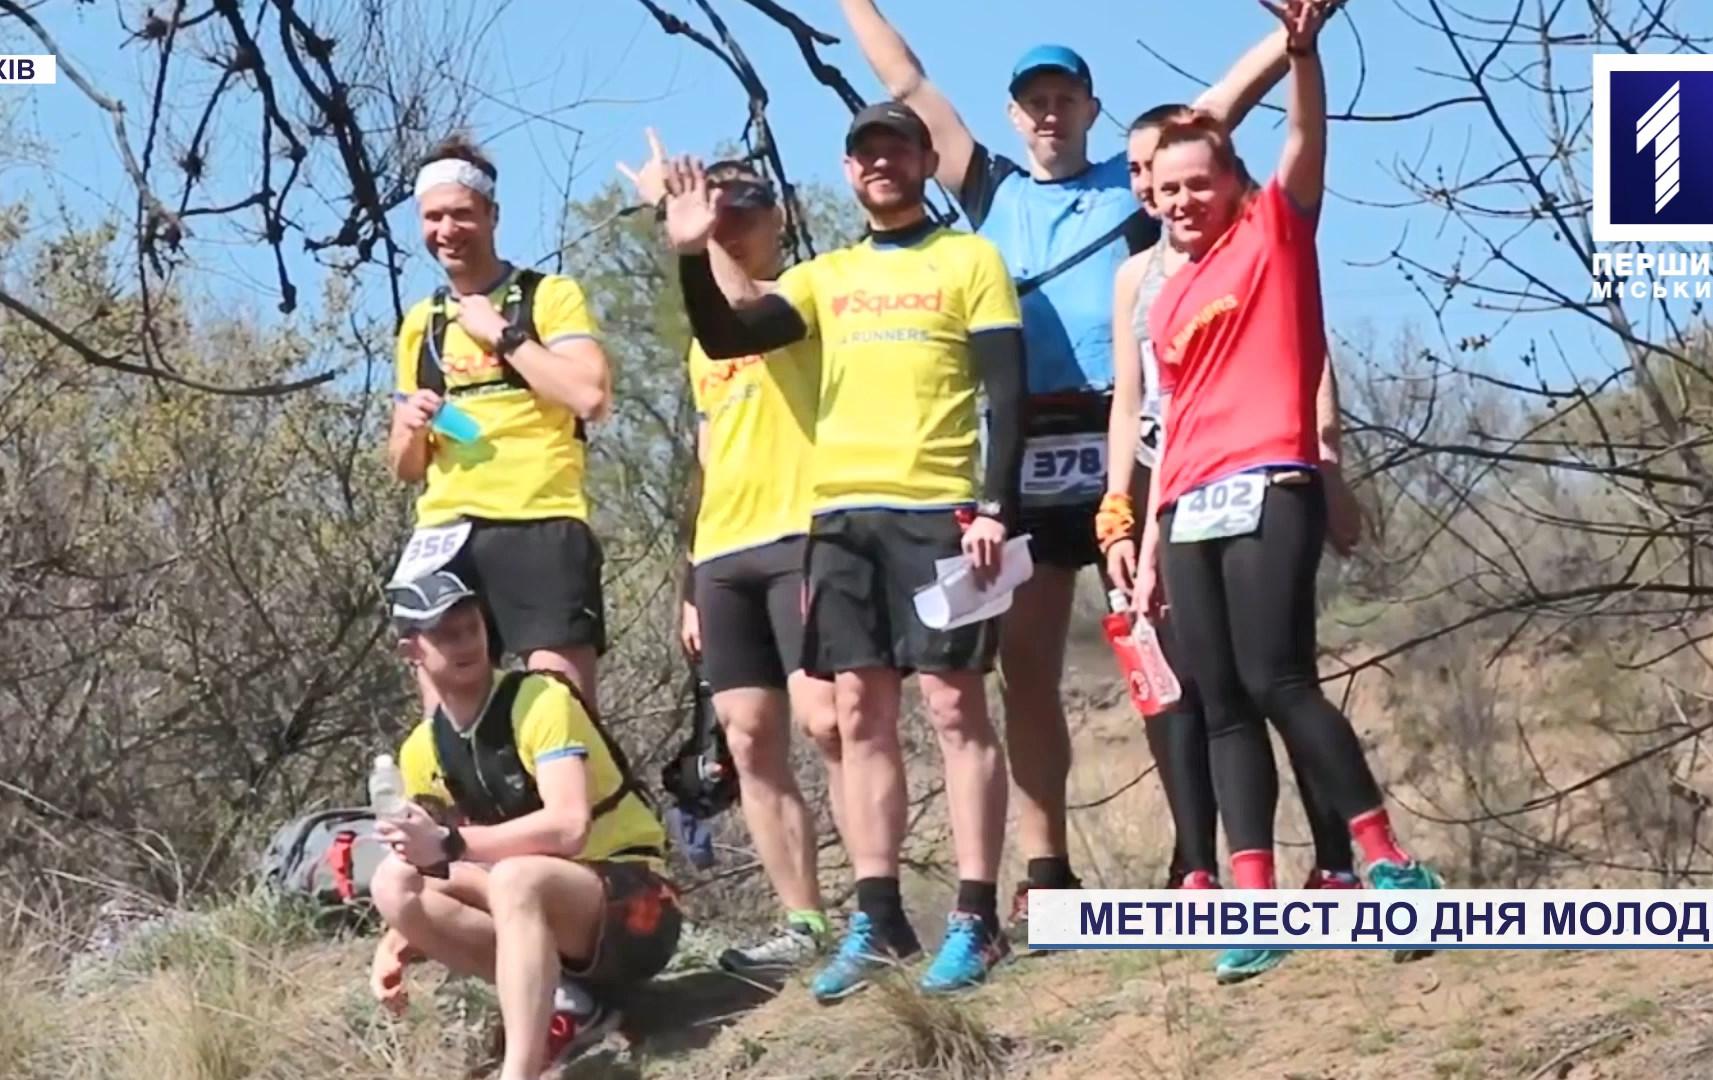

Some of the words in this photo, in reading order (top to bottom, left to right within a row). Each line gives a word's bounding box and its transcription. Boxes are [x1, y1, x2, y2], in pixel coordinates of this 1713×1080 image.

[850, 289, 943, 317] Squad
[1033, 447, 1101, 479] 378
[1187, 481, 1252, 513] 402
[407, 532, 459, 562] 356
